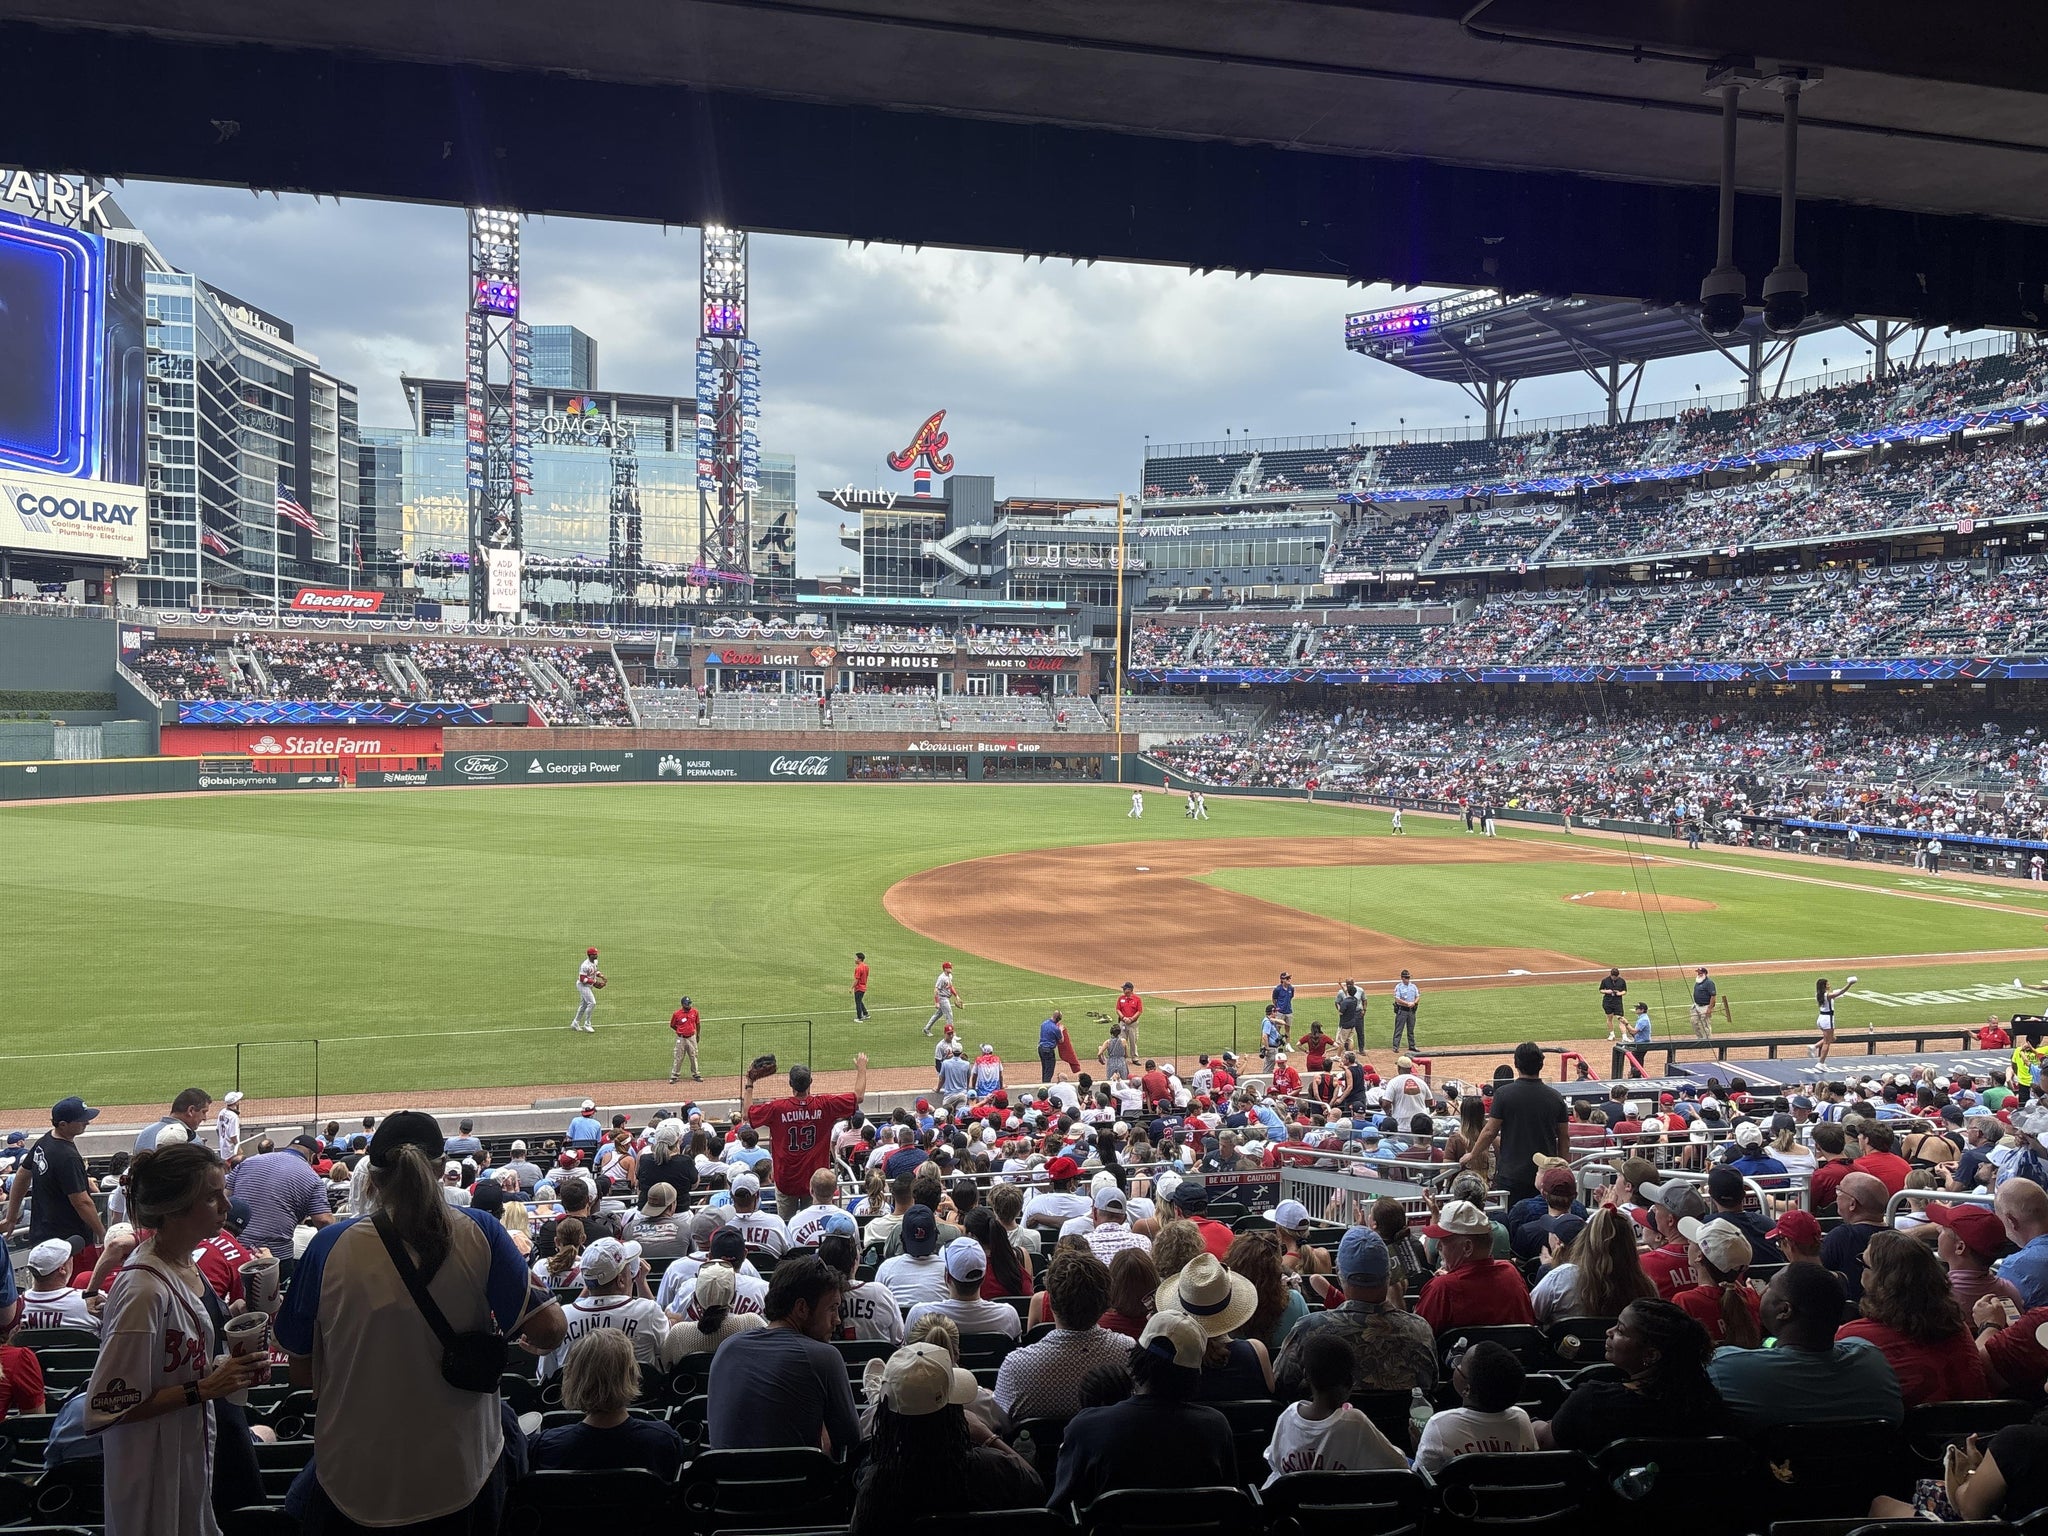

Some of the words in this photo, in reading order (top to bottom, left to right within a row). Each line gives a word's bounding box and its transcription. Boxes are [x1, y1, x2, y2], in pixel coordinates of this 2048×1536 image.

[0, 170, 112, 229] ARK
[832, 483, 898, 509] xfinity
[16, 493, 139, 525] COOLRAY
[51, 520, 81, 529] Cooling
[87, 524, 115, 533] Heating
[1957, 519, 1973, 534] 10
[59, 528, 94, 539] Plumbing
[100, 532, 134, 542] Electrical
[300, 592, 374, 608] RaceTrac
[722, 649, 762, 665] Coors
[763, 656, 799, 665] LIGHT
[847, 656, 885, 667] CHOP
[891, 656, 939, 667] HOUSE
[1027, 658, 1064, 670] Chill
[285, 736, 335, 754] State
[336, 737, 381, 754] Farm
[464, 757, 498, 772] Ford
[546, 762, 587, 775] Georgia
[590, 761, 621, 773] Power
[687, 760, 710, 768] KAISER
[394, 773, 428, 782] National
[687, 768, 735, 776] PERMANENTE
[199, 776, 277, 788] globalpayments
[811, 1109, 822, 1120] JR
[788, 1125, 816, 1151] 13
[1209, 1176, 1218, 1184] BE
[1220, 1175, 1240, 1183] ALERT
[1247, 1174, 1276, 1182] CAUTION
[745, 1228, 769, 1244] KER
[1669, 1267, 1699, 1288] ALB
[20, 1312, 63, 1330] SMITH
[93, 1391, 141, 1409] CHAMPIONS
